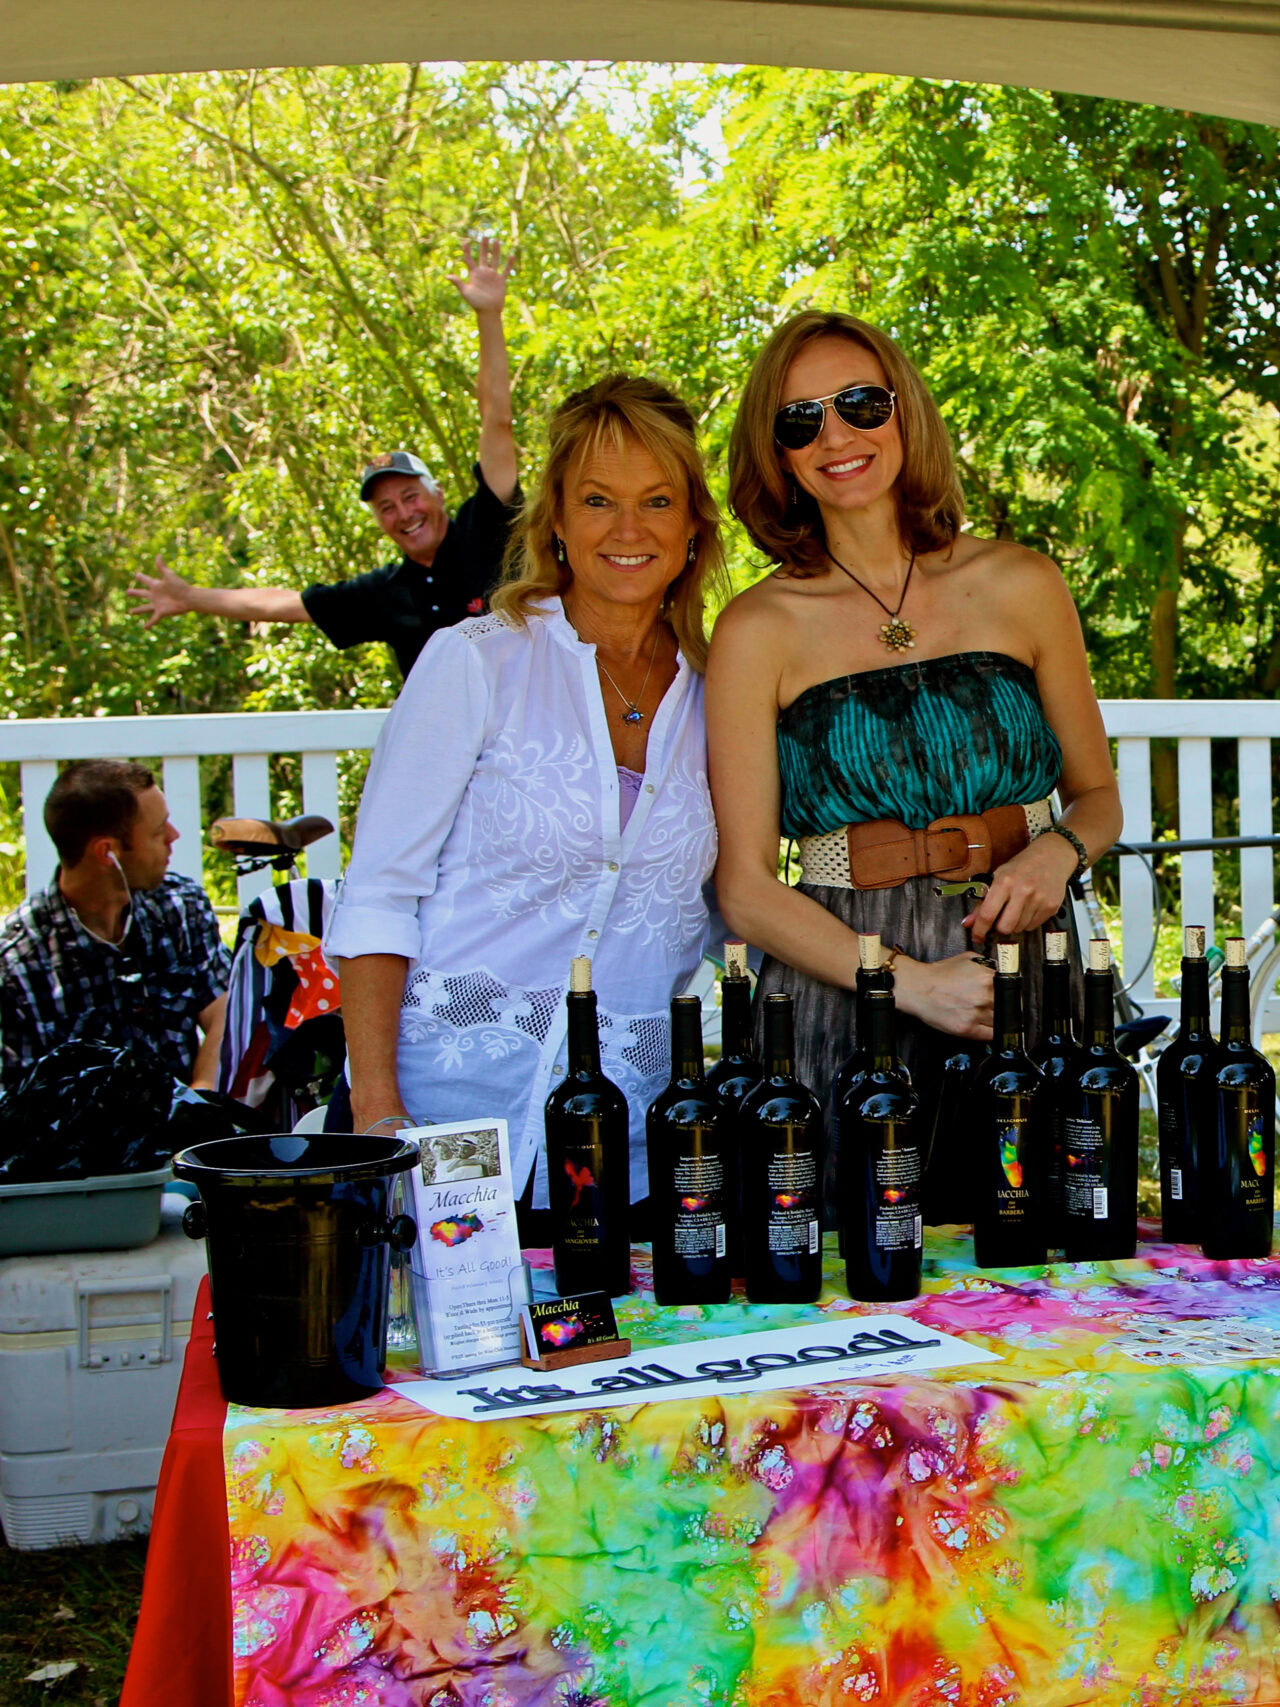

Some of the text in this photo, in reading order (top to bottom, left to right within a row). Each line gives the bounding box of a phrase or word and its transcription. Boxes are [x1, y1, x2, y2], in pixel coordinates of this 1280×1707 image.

[428, 1186, 498, 1212] Macchia
[532, 1299, 580, 1319] Macchia
[591, 1363, 687, 1391] all
